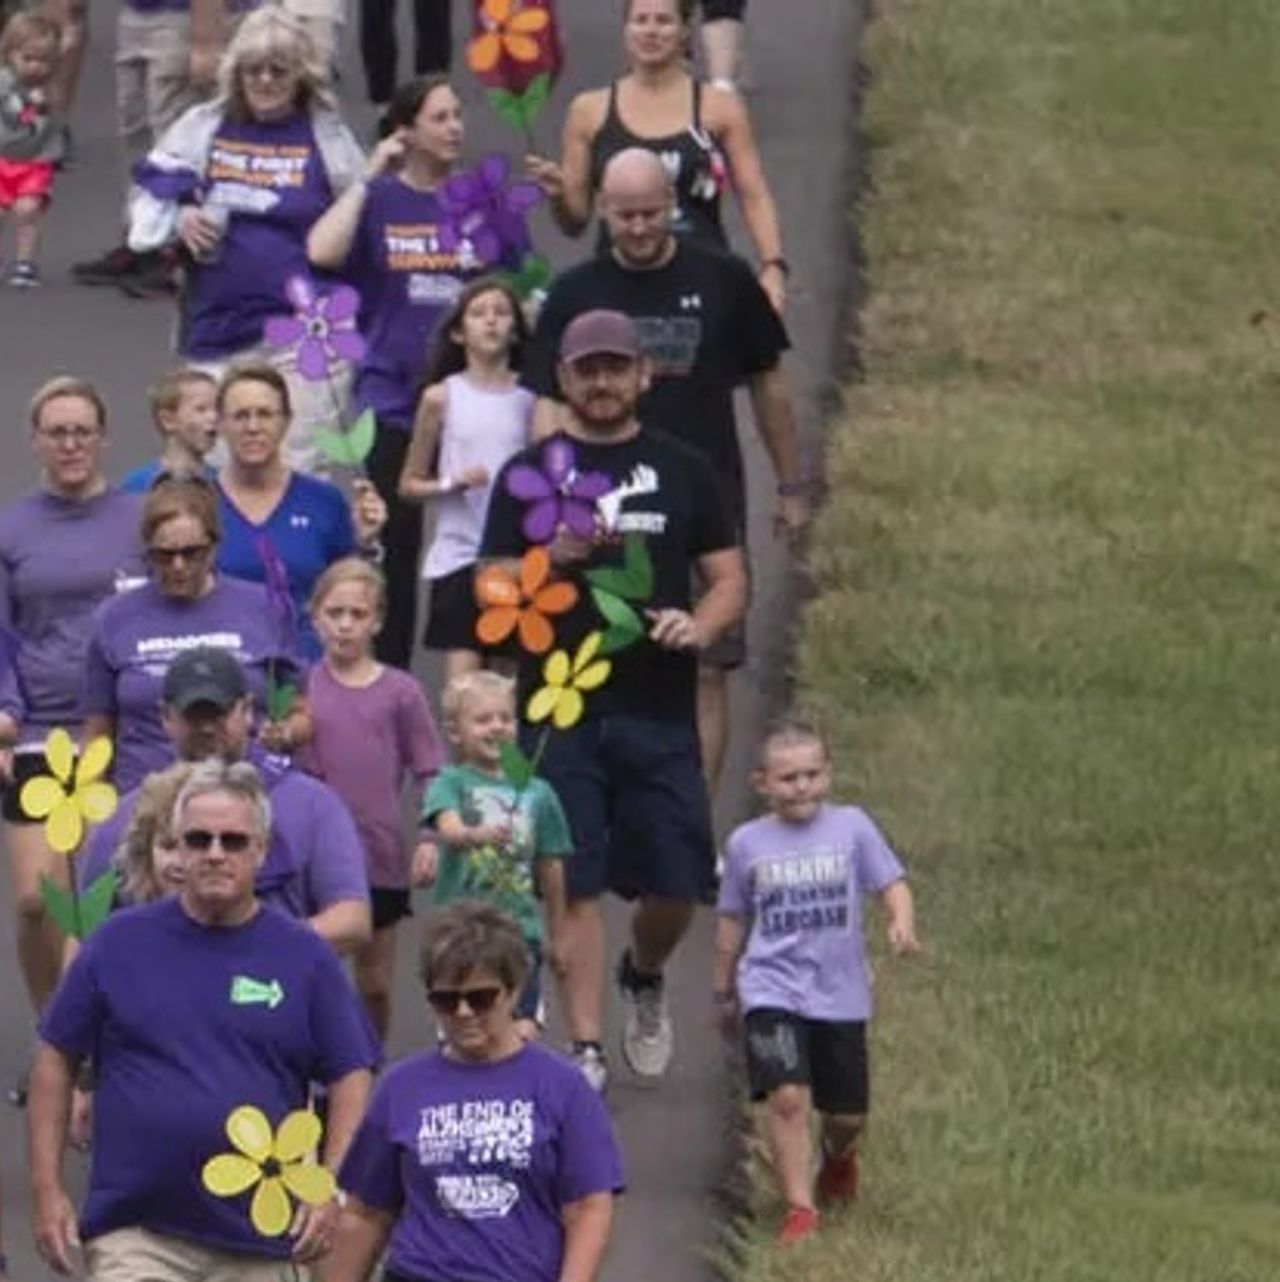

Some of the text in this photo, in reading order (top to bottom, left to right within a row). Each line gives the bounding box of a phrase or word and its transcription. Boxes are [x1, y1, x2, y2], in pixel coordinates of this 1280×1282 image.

[212, 150, 307, 171] THE FIRST
[386, 238, 426, 252] THE
[420, 1103, 458, 1121] THE
[461, 1099, 506, 1121] END
